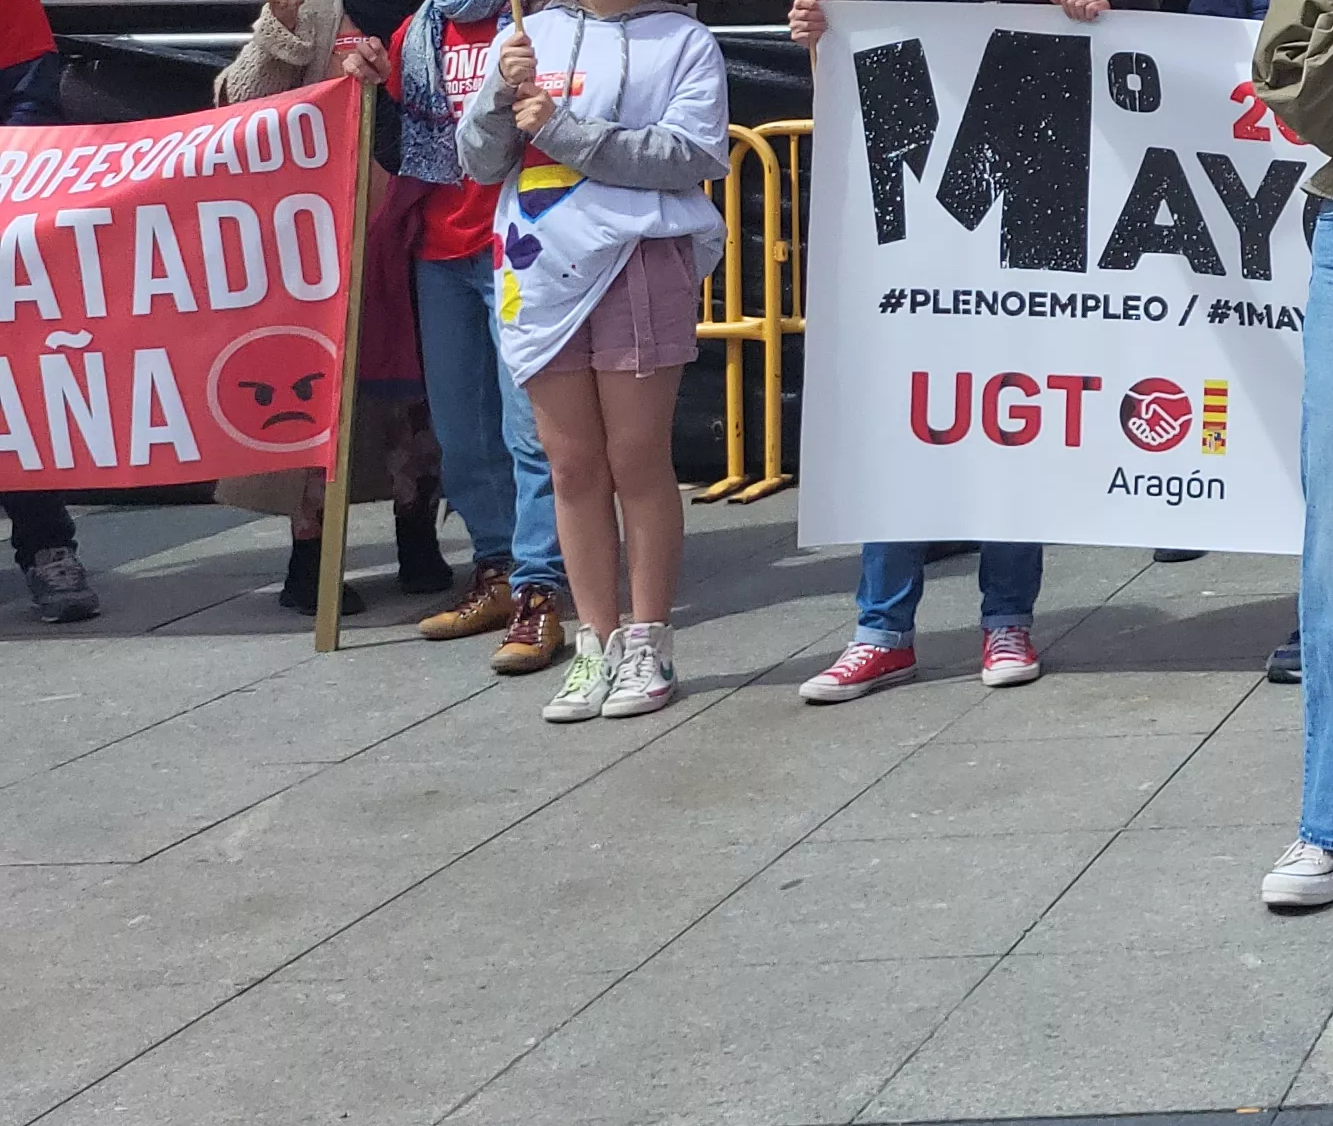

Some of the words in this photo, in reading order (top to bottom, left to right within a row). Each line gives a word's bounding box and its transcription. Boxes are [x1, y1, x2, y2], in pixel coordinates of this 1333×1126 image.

[878, 288, 1169, 322] #PLENOEMPLEO
[909, 371, 1102, 448] UGT
[1106, 466, 1226, 507] Aragón
